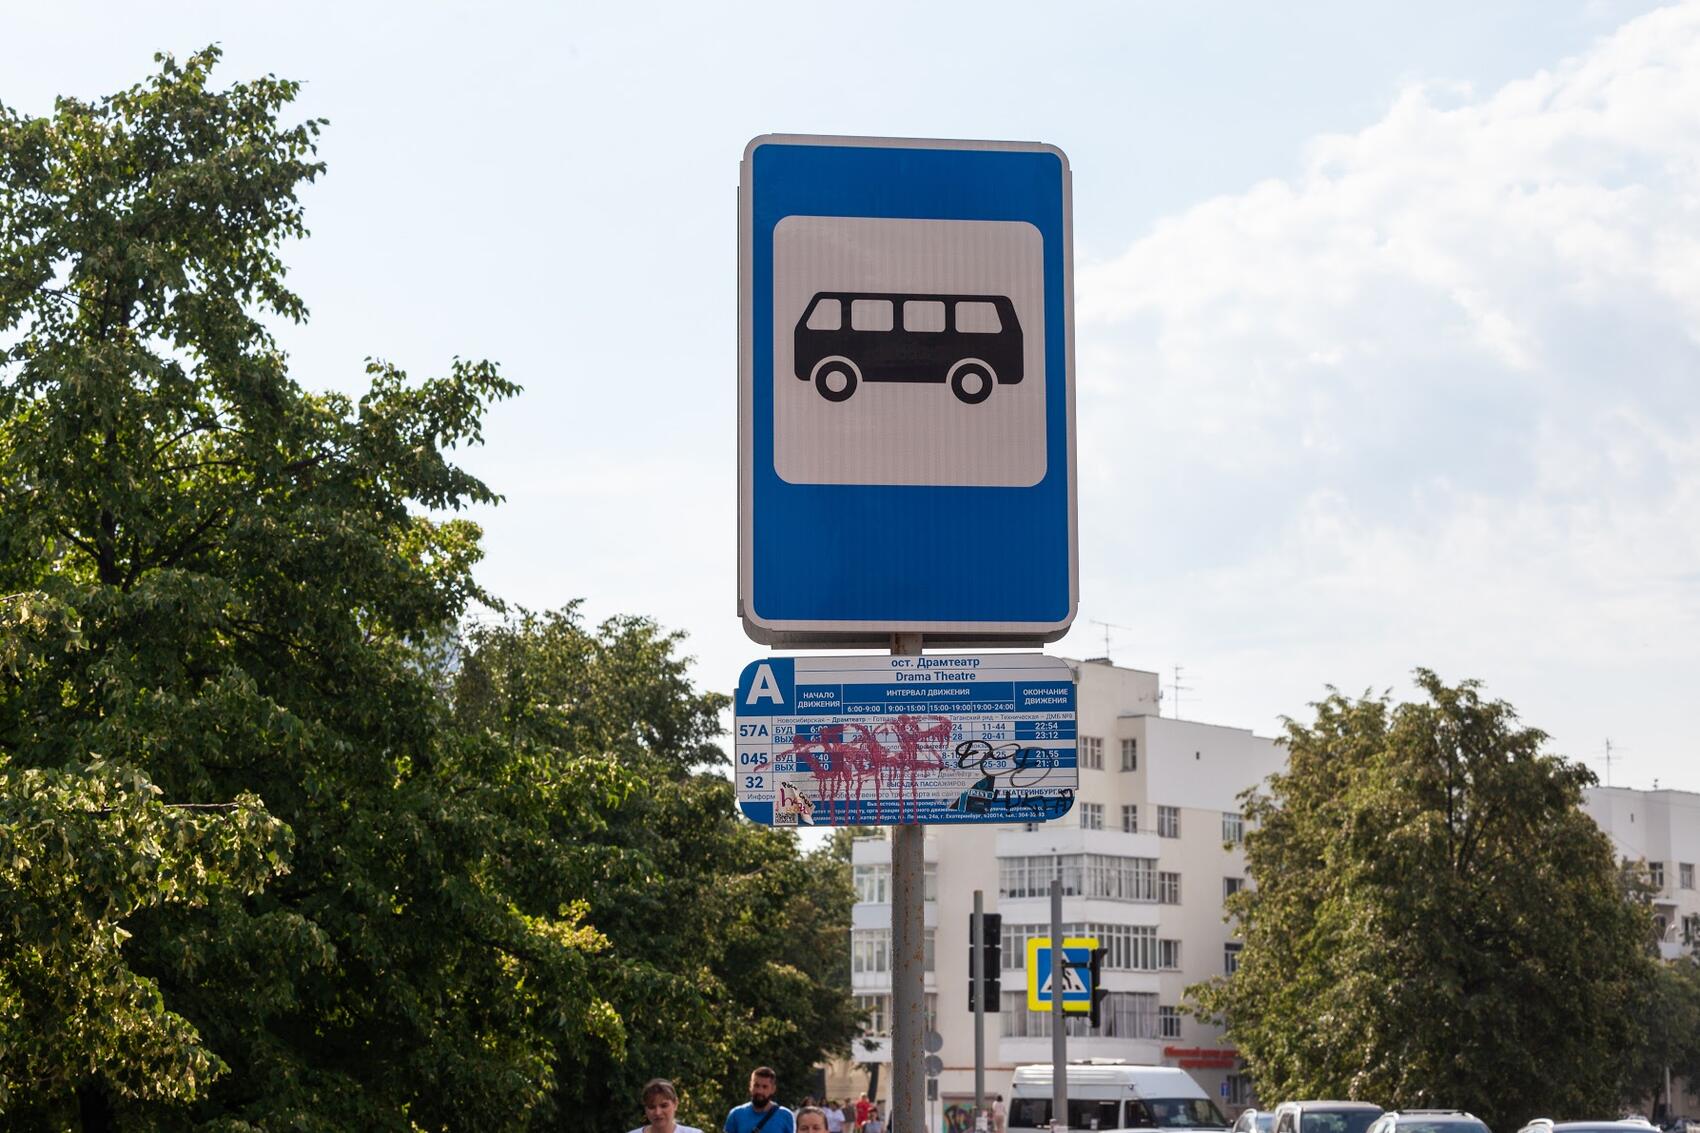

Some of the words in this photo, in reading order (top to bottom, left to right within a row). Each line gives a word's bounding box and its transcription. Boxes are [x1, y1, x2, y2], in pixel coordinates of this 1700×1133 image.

[892, 659, 914, 667] ост.
[917, 657, 980, 669] Драмтеатр
[896, 671, 931, 682] Drama
[934, 671, 976, 681] Theatre
[746, 664, 784, 704] А
[803, 691, 835, 699] НАЧАЛО
[886, 689, 926, 697] ИНТЕРВАЛ
[927, 688, 970, 697] ДВИЖЕНИЯ
[1022, 688, 1069, 696] ОКОНЧАНИЕ
[798, 700, 841, 709] ДВИЖЕНИЯ
[1024, 697, 1068, 706] ДВИЖЕНИЯ
[847, 705, 881, 713] 6:00-9:00
[888, 704, 926, 712] 9:00-15:00
[930, 704, 971, 712] 15:00-19:00
[973, 703, 1014, 711] 19:00-24:00
[832, 716, 866, 724] Драмтеатр
[1035, 722, 1058, 730] 22:54
[740, 724, 769, 737] 57А
[775, 726, 793, 735] БУД
[775, 735, 794, 743] ВЫХ
[982, 732, 1005, 740] 20-41
[1036, 731, 1059, 739] 23:12
[741, 752, 768, 765] 045
[775, 754, 793, 763] БУД
[983, 760, 1007, 768] 25-30
[1037, 759, 1060, 768] 21:0
[745, 776, 764, 789] 32
[920, 780, 966, 788] ПАССАЖИРОВ
